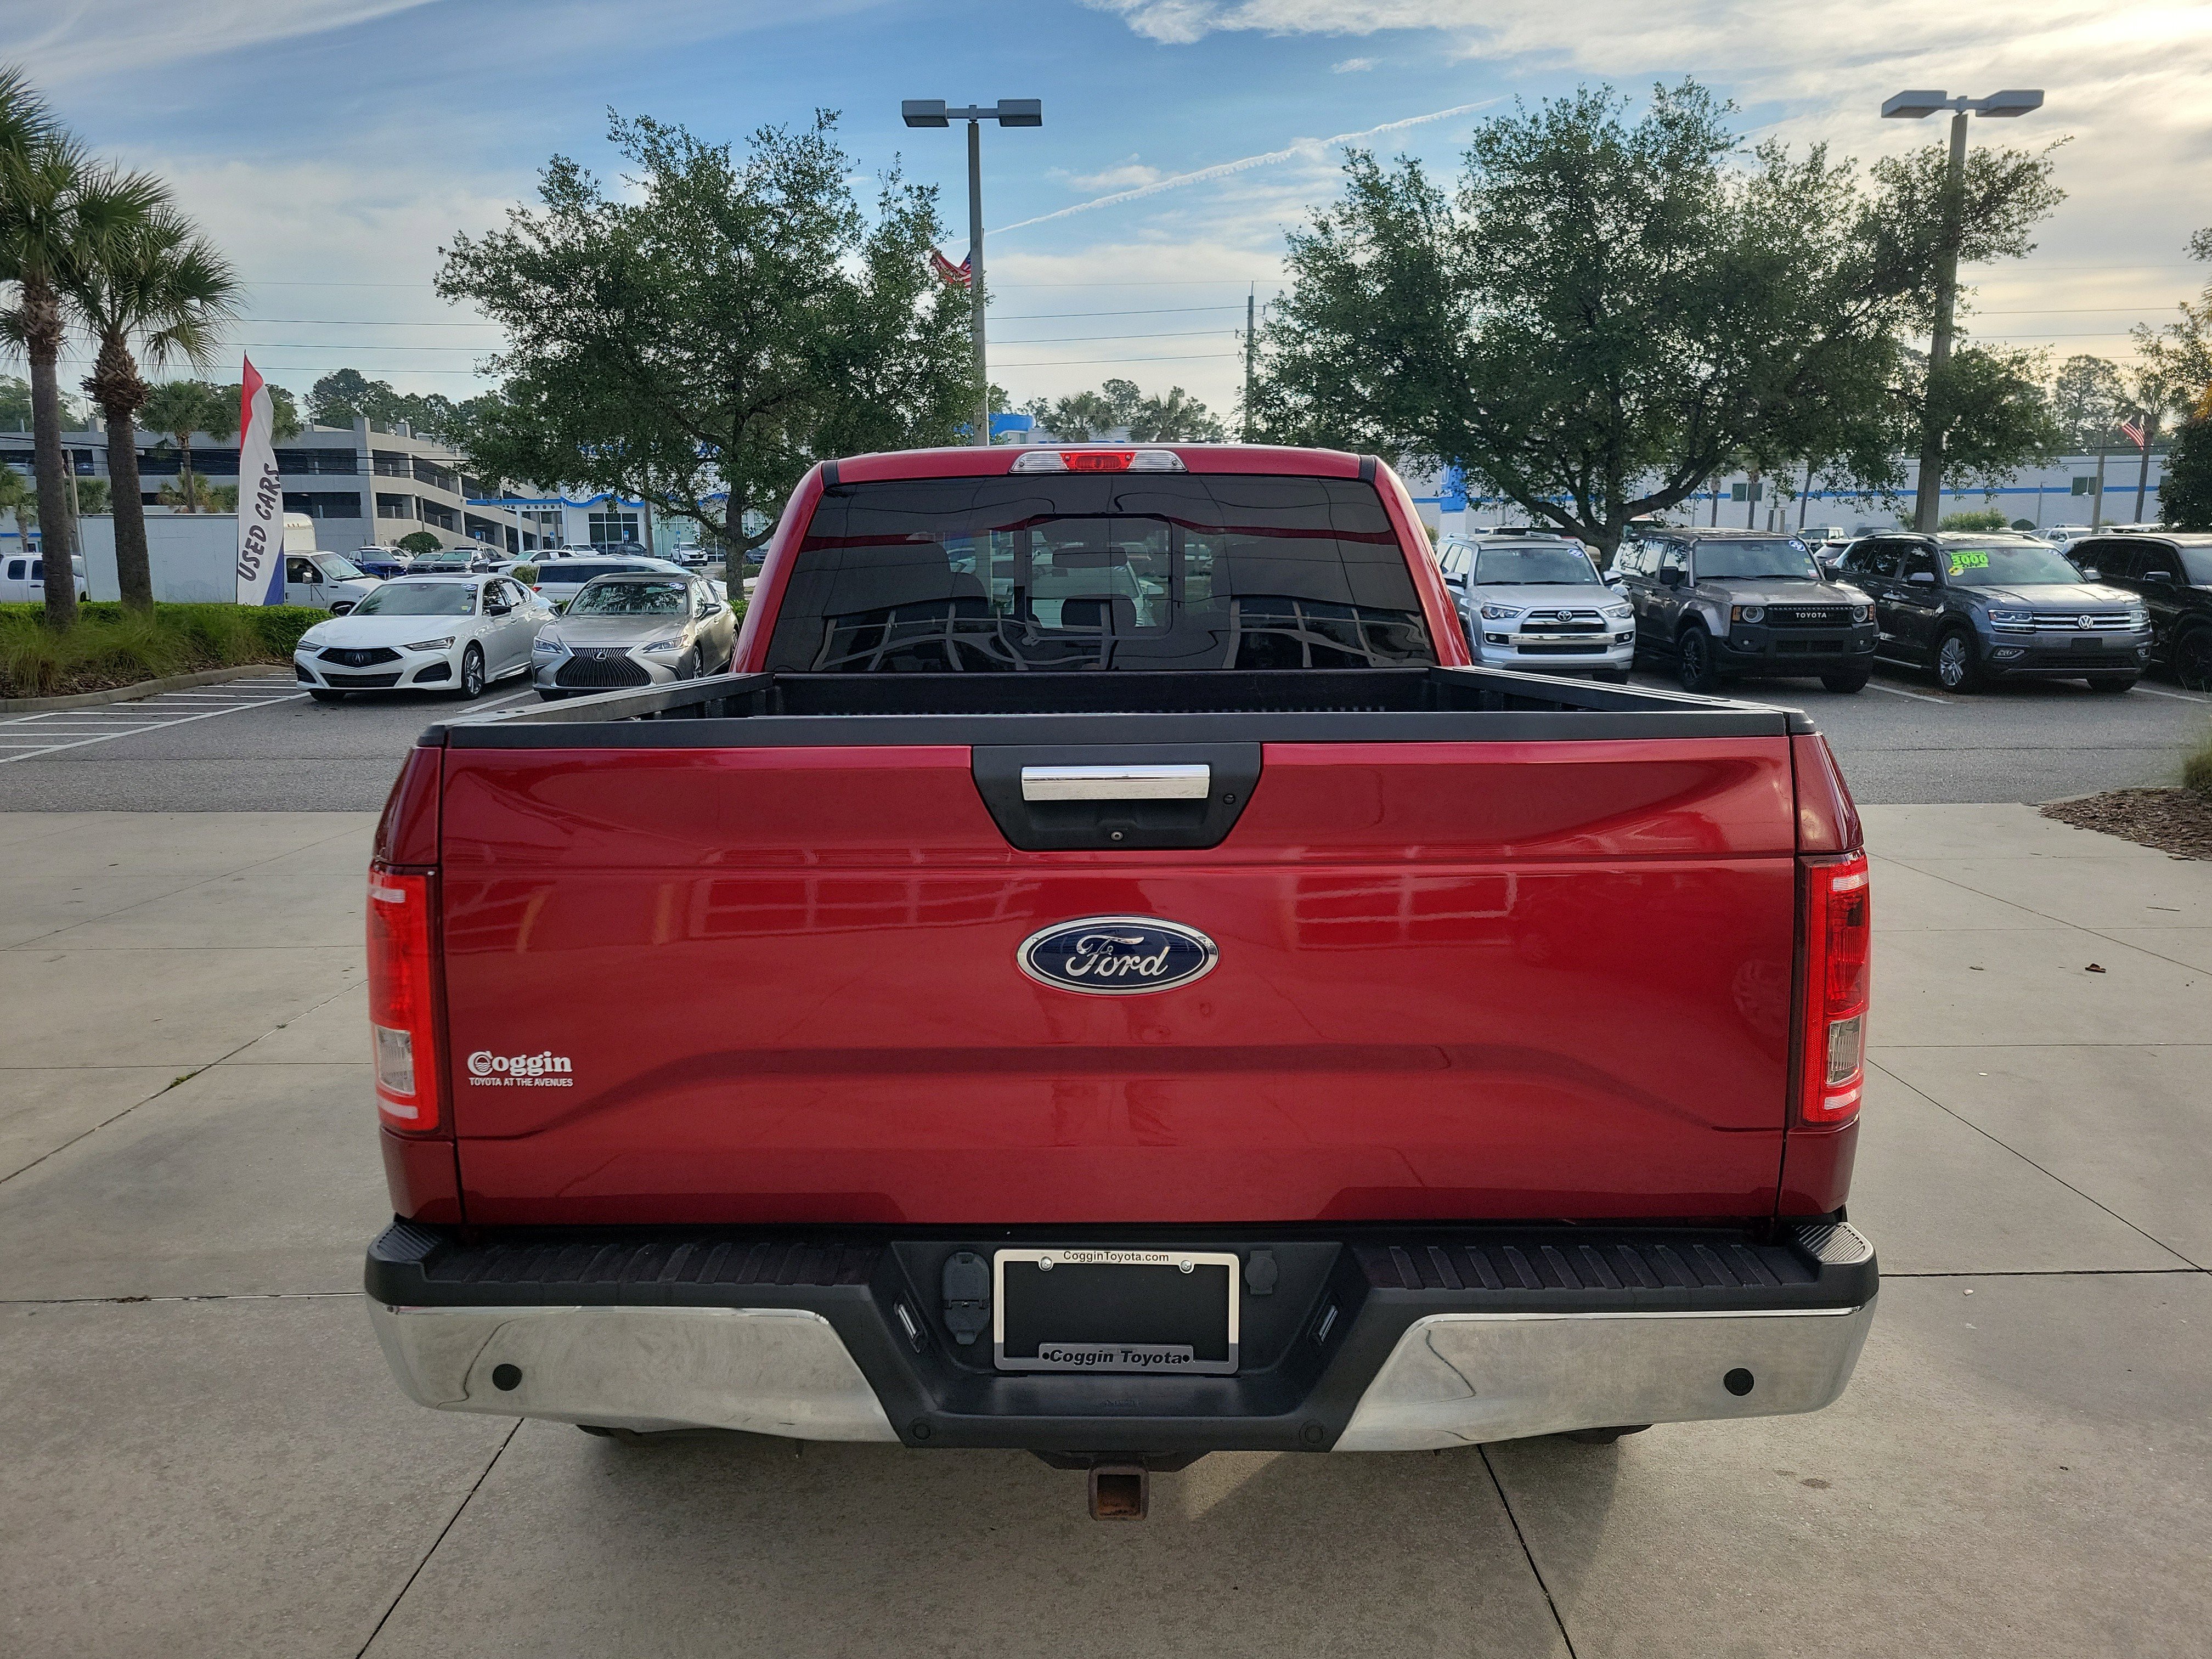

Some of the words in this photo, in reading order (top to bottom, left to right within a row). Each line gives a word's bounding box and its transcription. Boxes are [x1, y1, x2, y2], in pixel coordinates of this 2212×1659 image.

[238, 524, 267, 581] USED
[255, 462, 281, 521] CARS
[1951, 554, 1988, 565] 3000
[1065, 935, 1171, 977] Ford
[467, 1051, 573, 1076] Coggin
[469, 1077, 502, 1086] TOYOTA
[504, 1077, 515, 1086] AT
[515, 1077, 533, 1087] THE
[534, 1077, 574, 1087] AVENUES
[1063, 1250, 1169, 1262] CogginToyota.com
[1049, 1349, 1114, 1366] Coggin
[1120, 1350, 1182, 1367] Toyota
